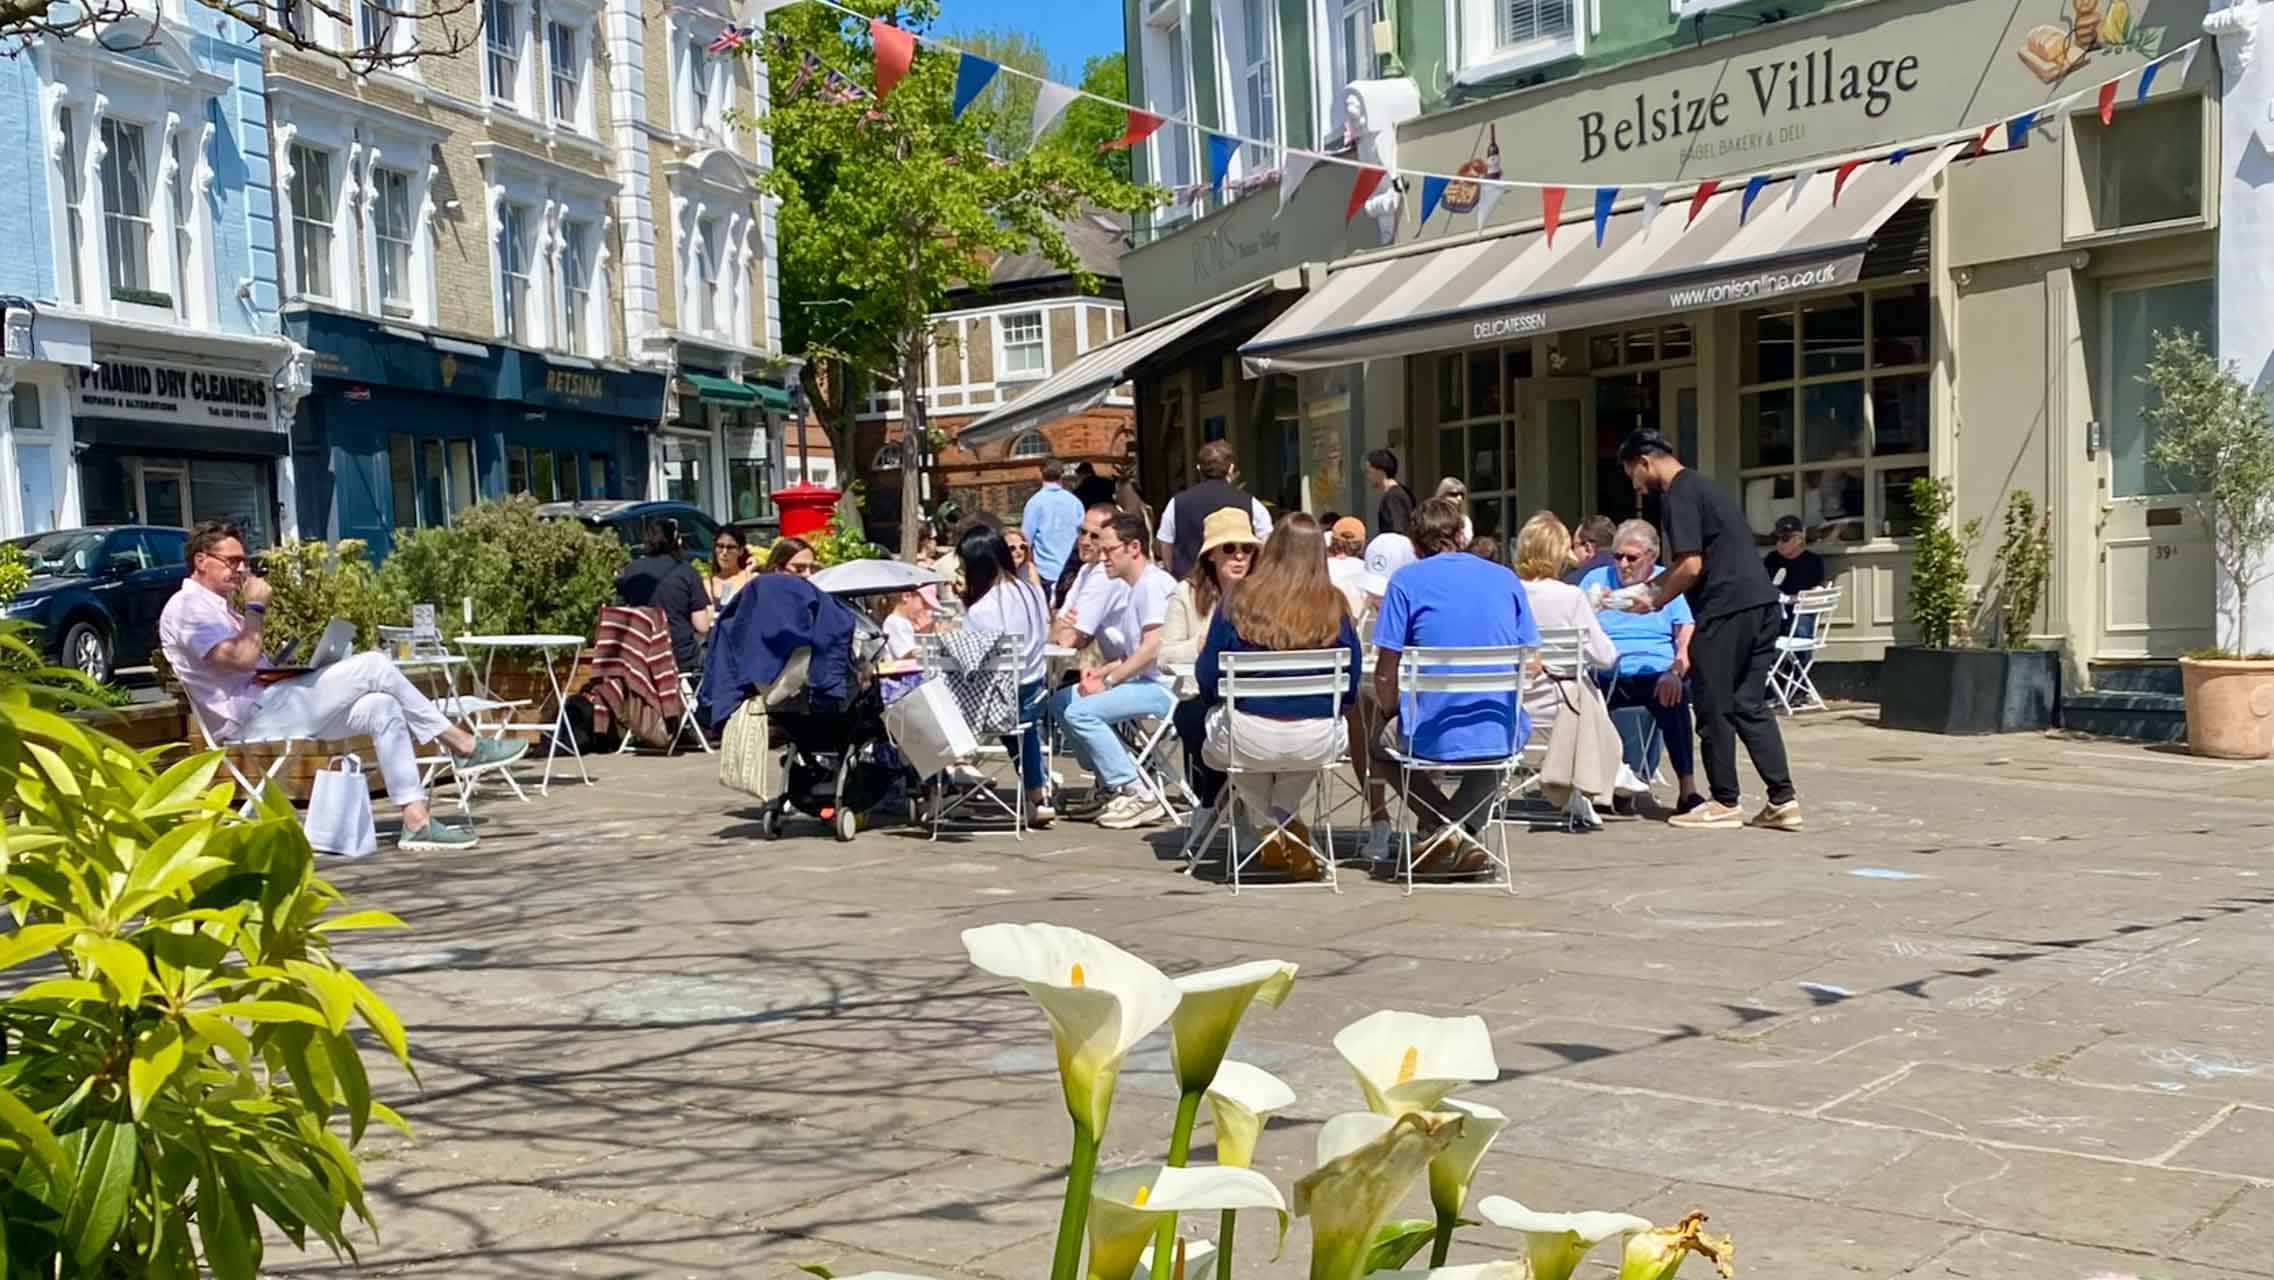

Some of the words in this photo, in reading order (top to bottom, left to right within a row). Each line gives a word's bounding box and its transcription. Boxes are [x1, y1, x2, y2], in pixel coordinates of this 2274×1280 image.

[1578, 90, 1729, 162] Belsize
[1746, 48, 1918, 117] Village
[1720, 132, 1761, 156] BAKERY
[1767, 131, 1774, 146] &
[1779, 122, 1806, 144] DELI
[1669, 263, 1835, 308] www.ronisonline.co.uk
[1472, 312, 1546, 339] DELICATESSEN
[79, 361, 151, 395] PYRAMID
[155, 367, 187, 398] DRY
[191, 371, 267, 407] CLEANERS
[547, 369, 604, 400] RETSINA
